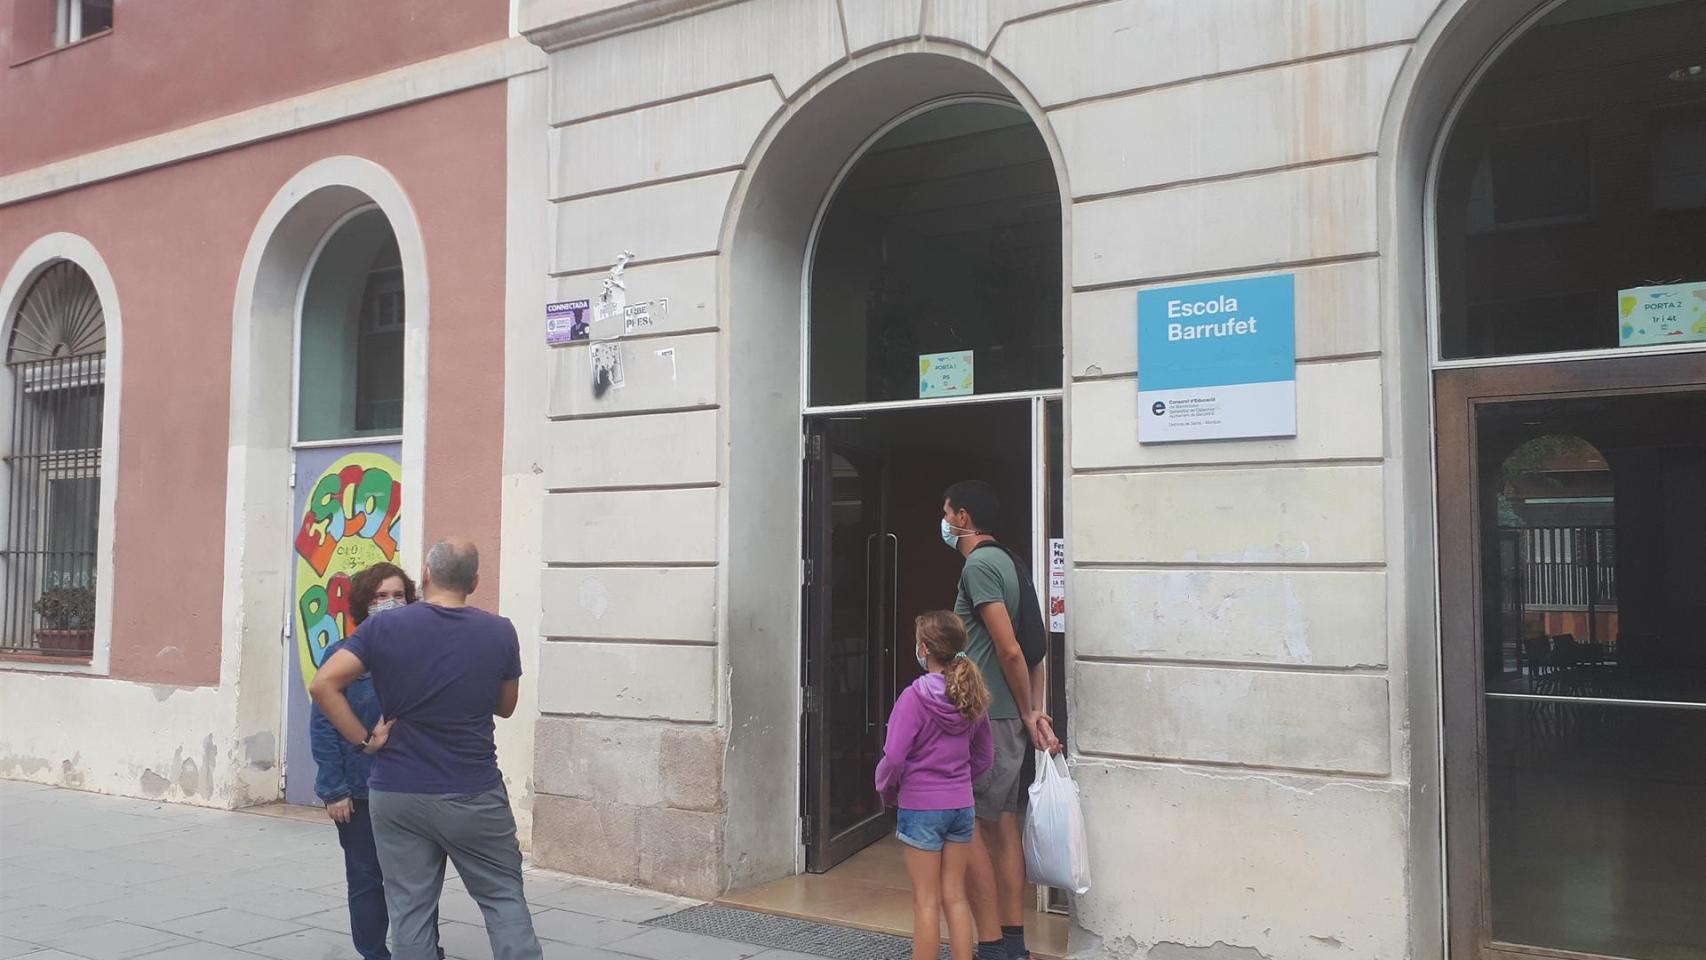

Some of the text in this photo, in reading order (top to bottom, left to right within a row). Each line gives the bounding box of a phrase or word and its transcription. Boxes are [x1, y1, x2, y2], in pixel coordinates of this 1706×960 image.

[548, 301, 588, 312] CONNECTADA
[1168, 295, 1238, 319] Escola
[1644, 302, 1676, 310] PORTA
[1168, 316, 1257, 342] Barrufet
